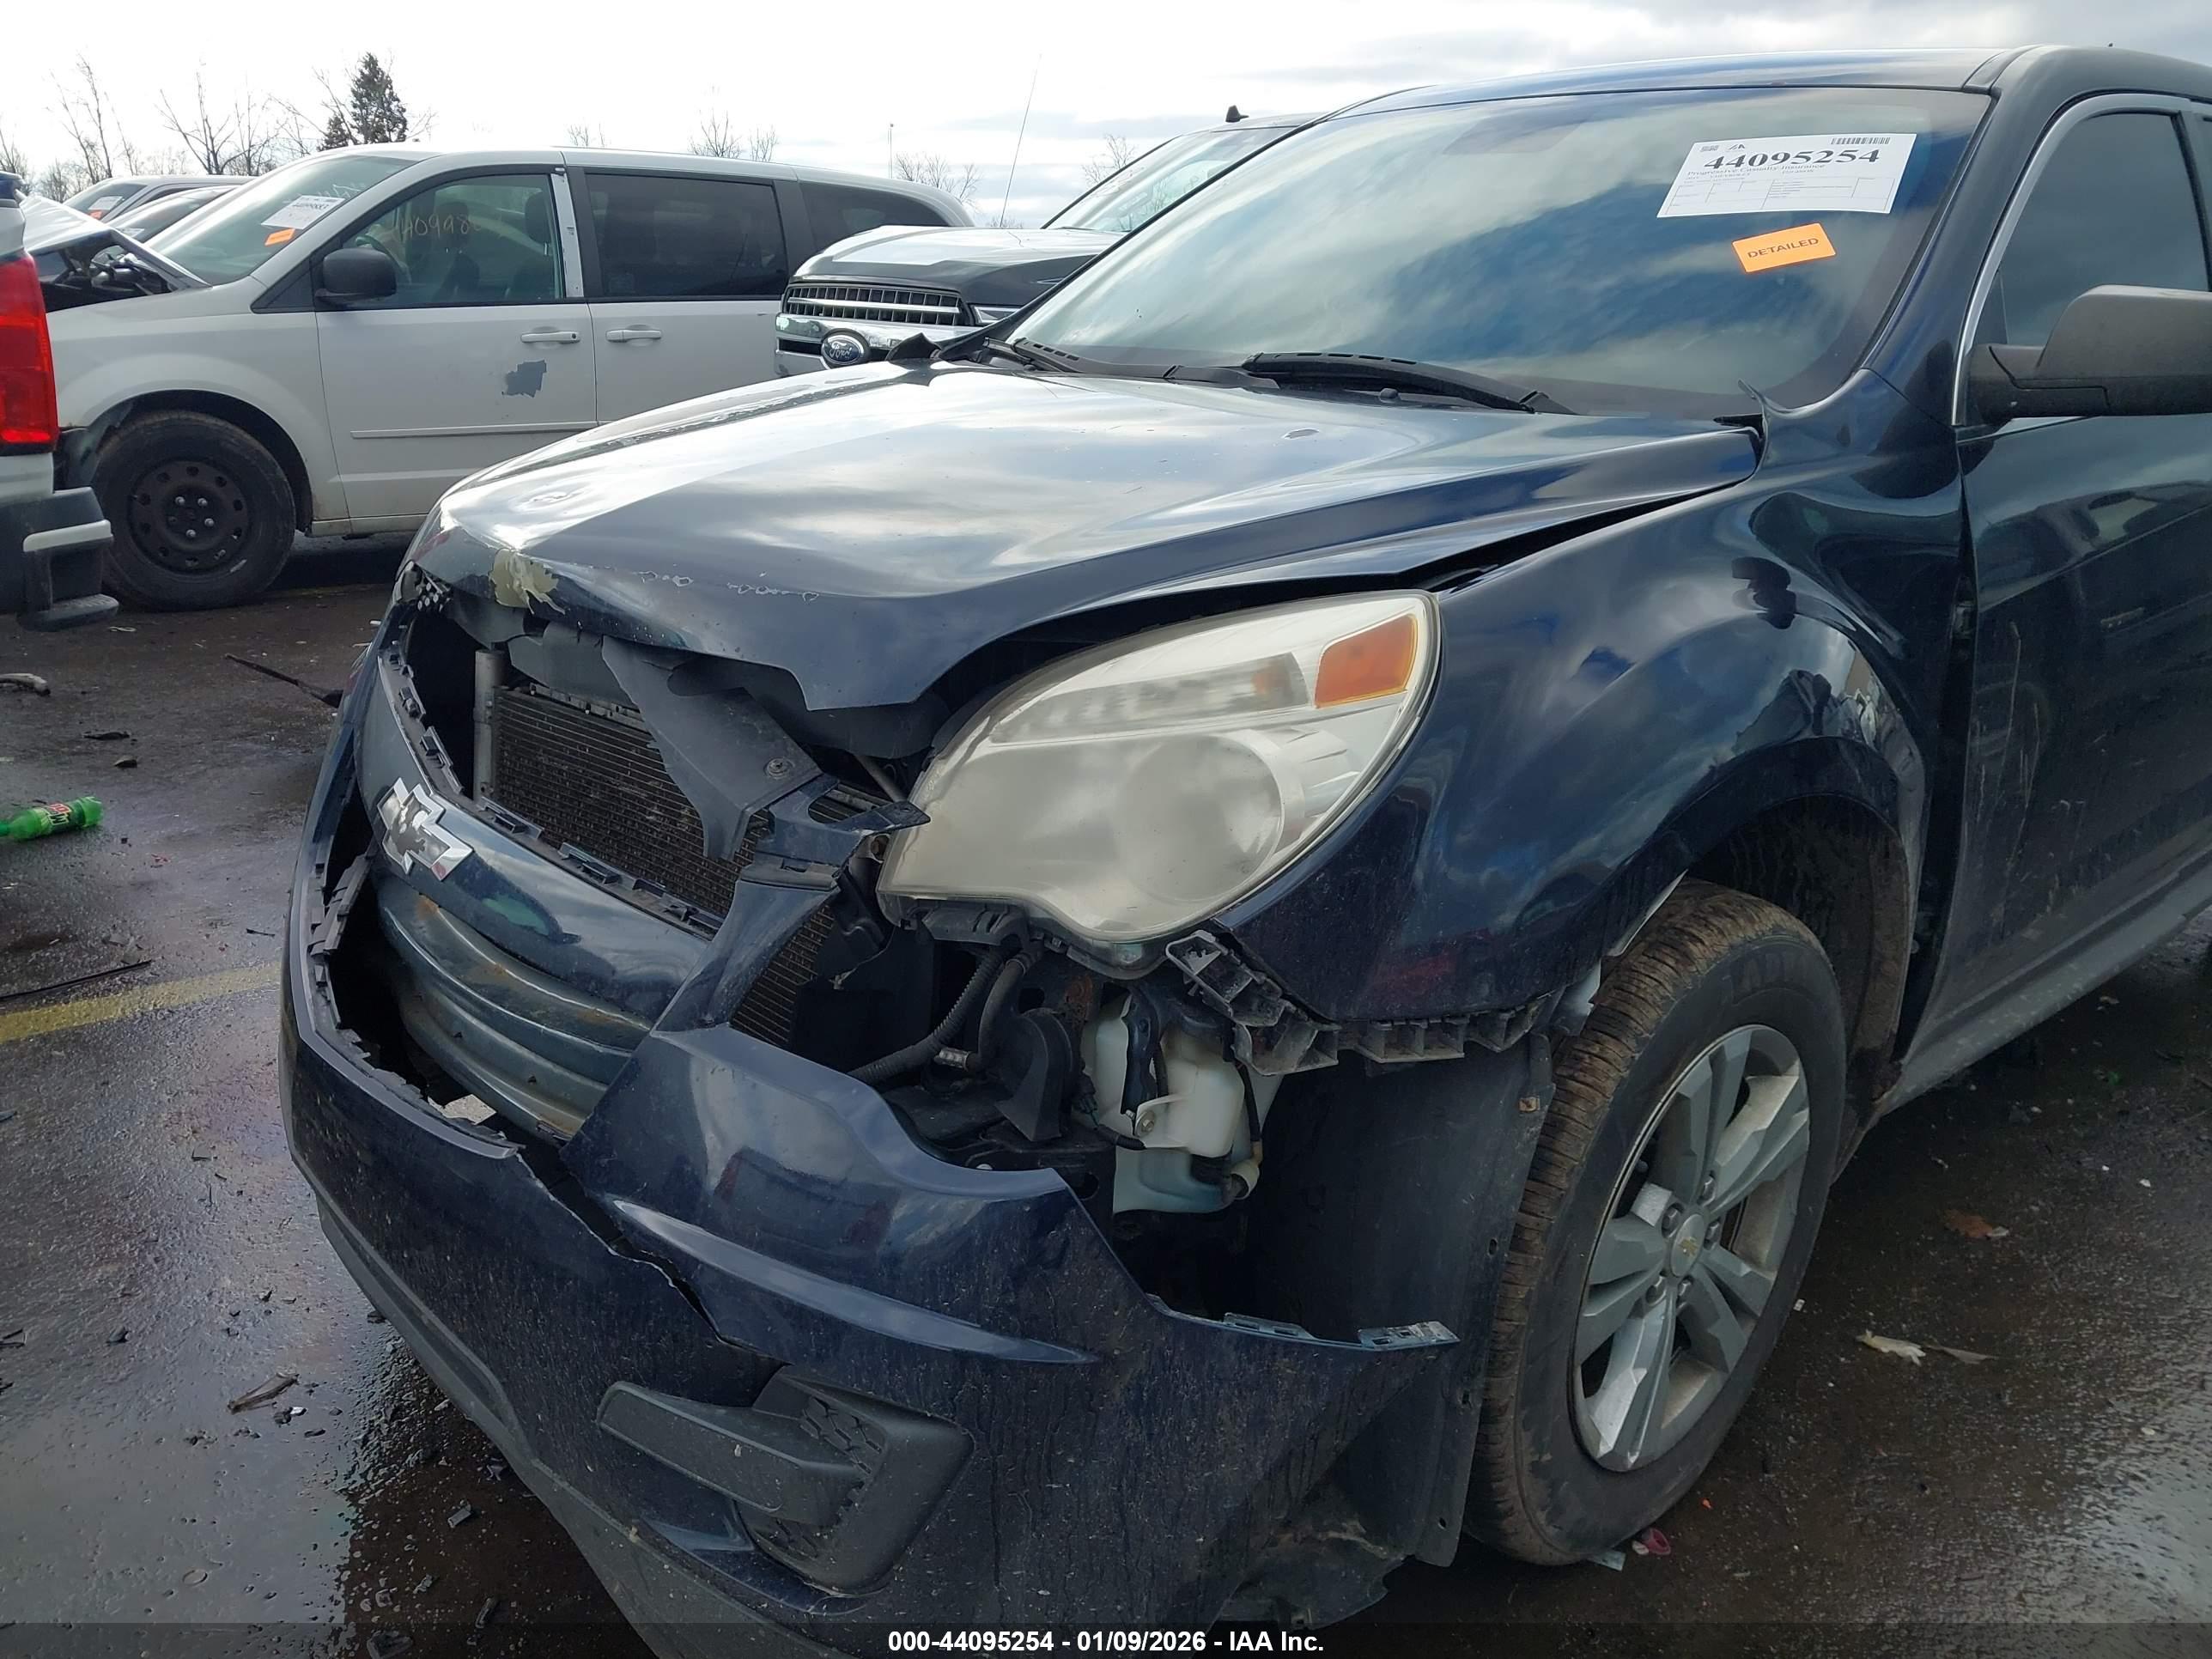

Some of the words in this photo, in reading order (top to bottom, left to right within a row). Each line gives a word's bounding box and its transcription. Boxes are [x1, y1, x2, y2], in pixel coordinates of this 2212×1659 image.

[1704, 149, 1880, 169] 44095254
[1747, 238, 1820, 258] DETAILED
[830, 341, 853, 358] Ford
